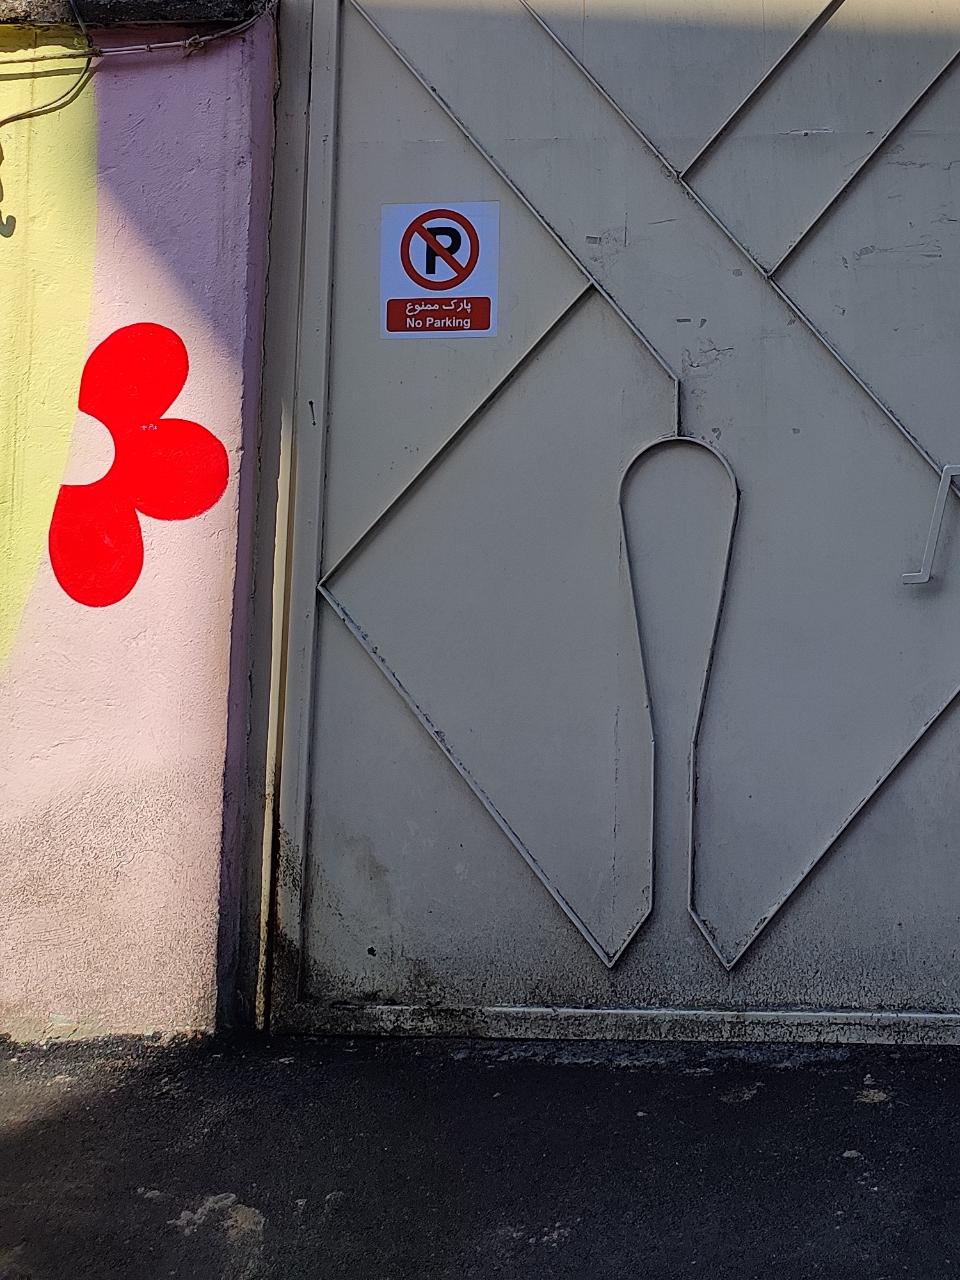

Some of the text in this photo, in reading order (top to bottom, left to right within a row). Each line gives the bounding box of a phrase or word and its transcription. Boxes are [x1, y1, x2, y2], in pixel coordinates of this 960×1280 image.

[405, 299, 471, 315] پارک ممنوع
[406, 317, 471, 329] No Parking
